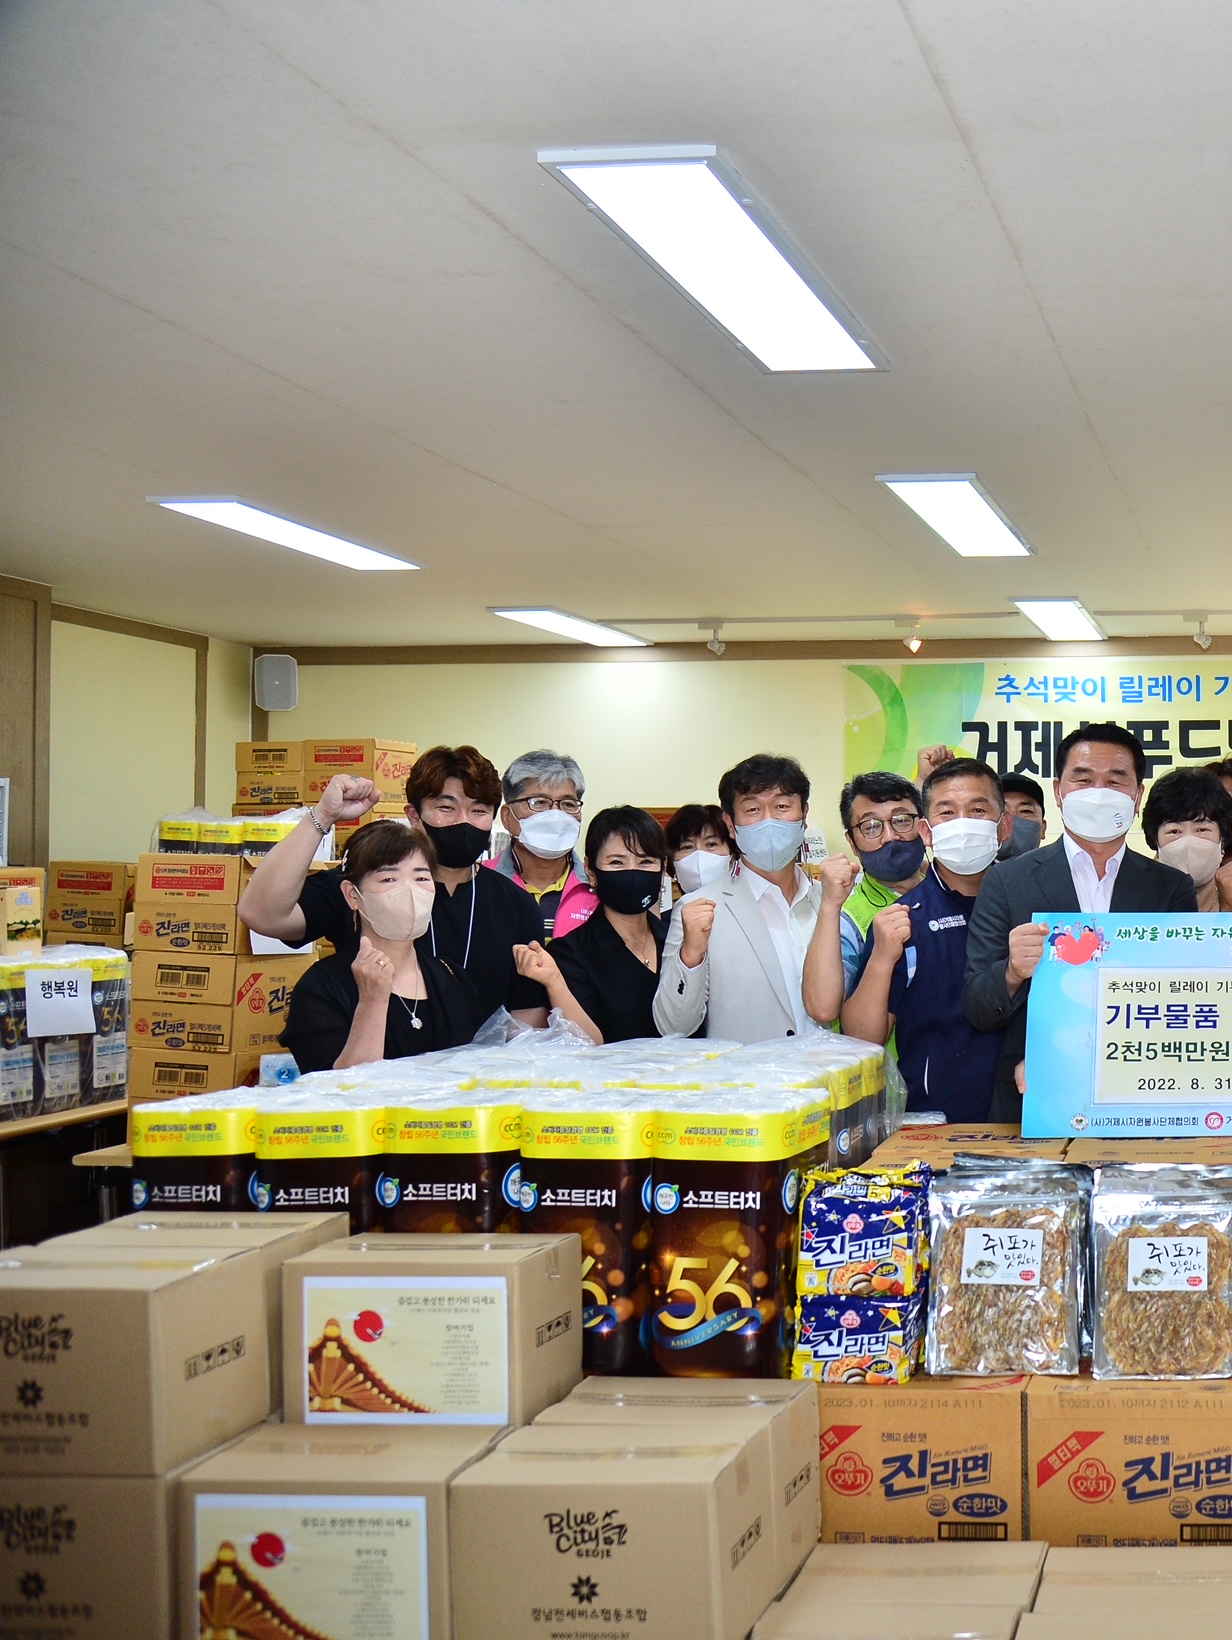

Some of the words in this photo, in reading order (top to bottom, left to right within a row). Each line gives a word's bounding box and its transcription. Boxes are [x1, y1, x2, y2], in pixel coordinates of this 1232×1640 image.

[994, 674, 1107, 703] 추석맞이
[1118, 674, 1202, 703] 릴레이
[155, 919, 191, 937] 진라면
[1115, 925, 1160, 941] 세상을
[1165, 926, 1206, 941] 바꾸는
[40, 979, 79, 1000] 행복원
[1107, 980, 1162, 994] 추석맞이
[1168, 980, 1209, 994] 릴레이
[1106, 1002, 1220, 1030] 기부물품
[151, 1020, 187, 1037] 진라면
[1106, 1040, 1231, 1062] 2천5백만원
[1137, 1077, 1182, 1091] 2022.
[1190, 1077, 1205, 1091] 8.
[151, 1185, 221, 1203] 소프트터치
[275, 1186, 349, 1206] 소프트터치
[403, 1183, 476, 1201] 소프트터치
[541, 1189, 616, 1207] 소프트터치
[683, 1190, 761, 1210] 소프트터치
[812, 1233, 893, 1269] 진라면
[982, 1233, 1037, 1256] 쥐포가
[1147, 1242, 1202, 1263] 쥐포가
[658, 1257, 752, 1331] 56
[671, 1311, 739, 1347] ANNIVERSARY
[810, 1328, 889, 1360] 진라면
[902, 1432, 917, 1442] 순한
[1145, 1434, 1159, 1444] 순한
[1047, 1437, 1082, 1471] 멀티팩
[834, 1472, 865, 1486] 오뚜기
[879, 1448, 993, 1500] 진라면
[1076, 1479, 1108, 1493] 오뚜기
[957, 1498, 1002, 1513] 순한맛
[544, 1508, 600, 1534] Blue
[556, 1527, 600, 1553] City
[576, 1548, 613, 1559] GEOJE
